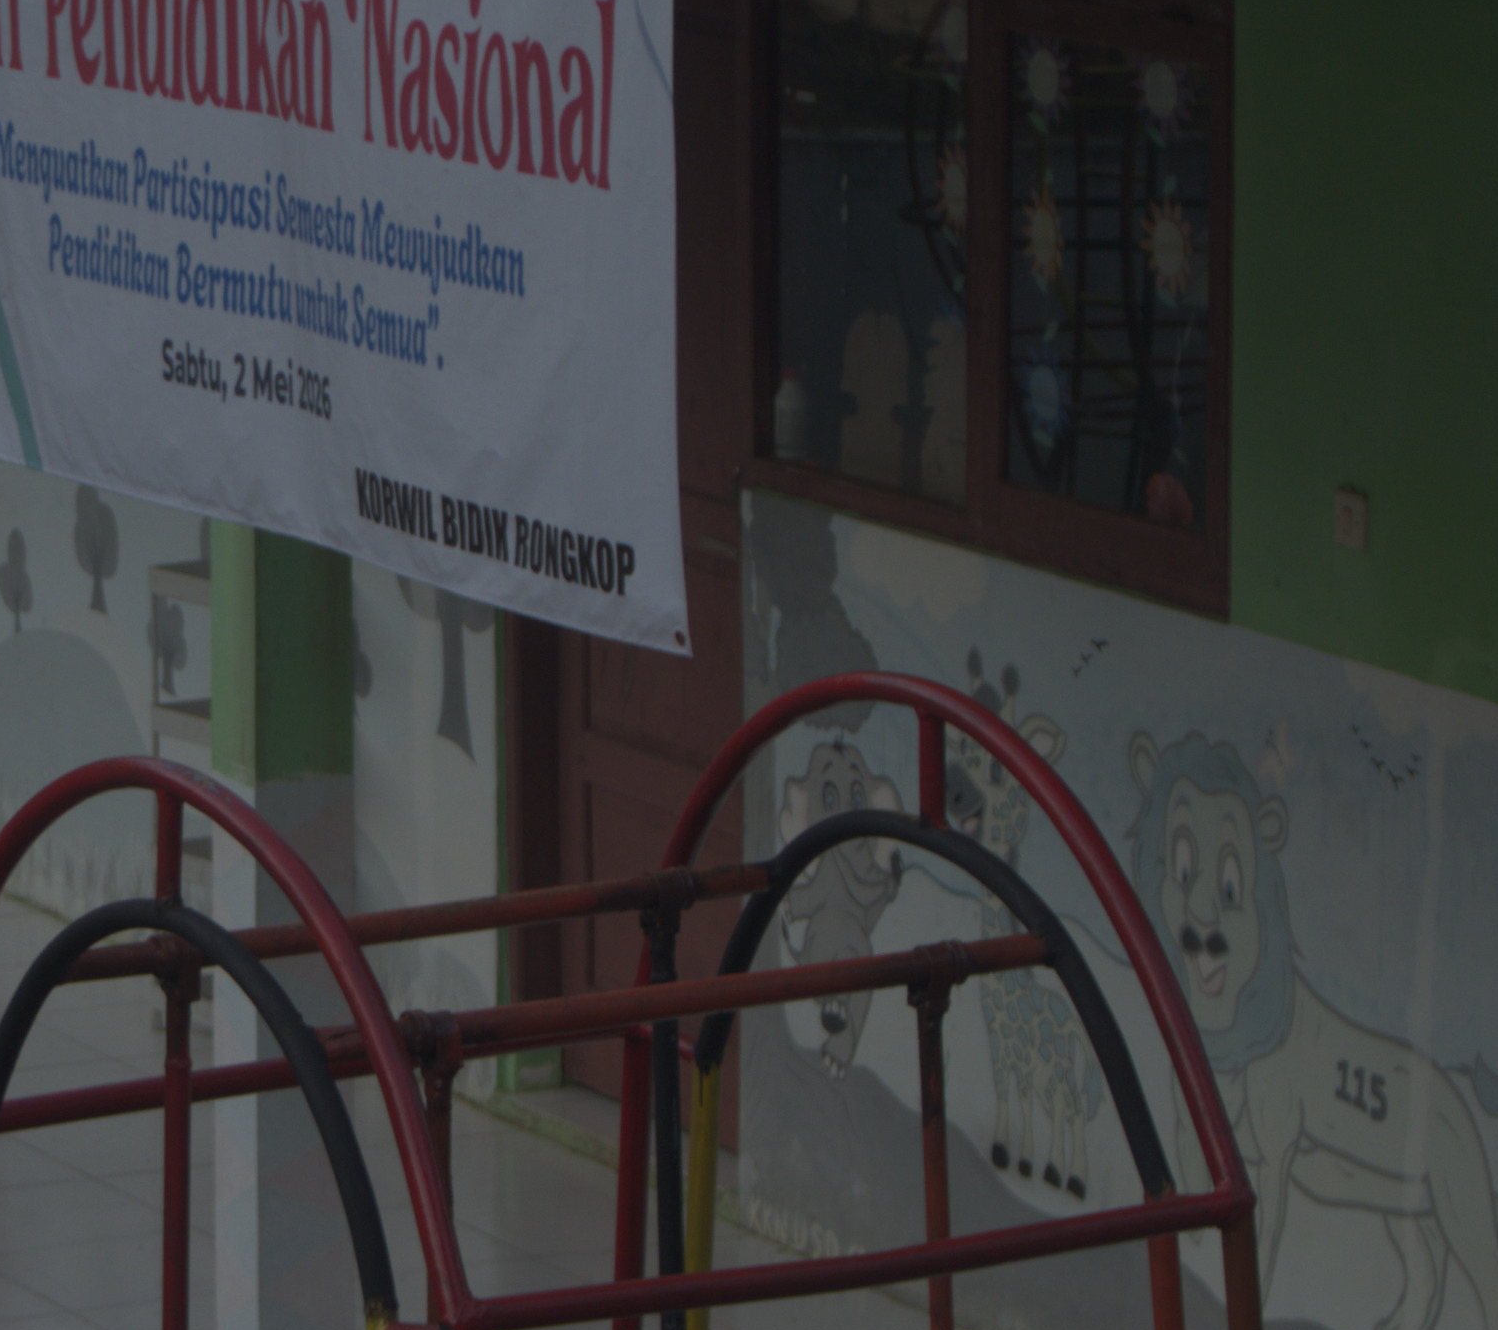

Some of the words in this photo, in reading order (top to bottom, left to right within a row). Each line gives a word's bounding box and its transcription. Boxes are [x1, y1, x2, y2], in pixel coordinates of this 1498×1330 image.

[48, 212, 171, 301] Pendidikan
[176, 241, 293, 323] Bermutu
[294, 278, 350, 344] untuk
[132, 146, 272, 240] Partisipasi
[275, 172, 357, 258] Semesta
[360, 197, 526, 298] Mewujudkan
[161, 337, 228, 402] Sabtu,
[233, 352, 247, 398] 2
[252, 356, 294, 406] Mei
[297, 365, 332, 421] 2026
[355, 467, 438, 543] KORWIL
[440, 494, 509, 563] BIDIK
[514, 514, 636, 597] RONGKOP
[1335, 1059, 1388, 1122] 115
